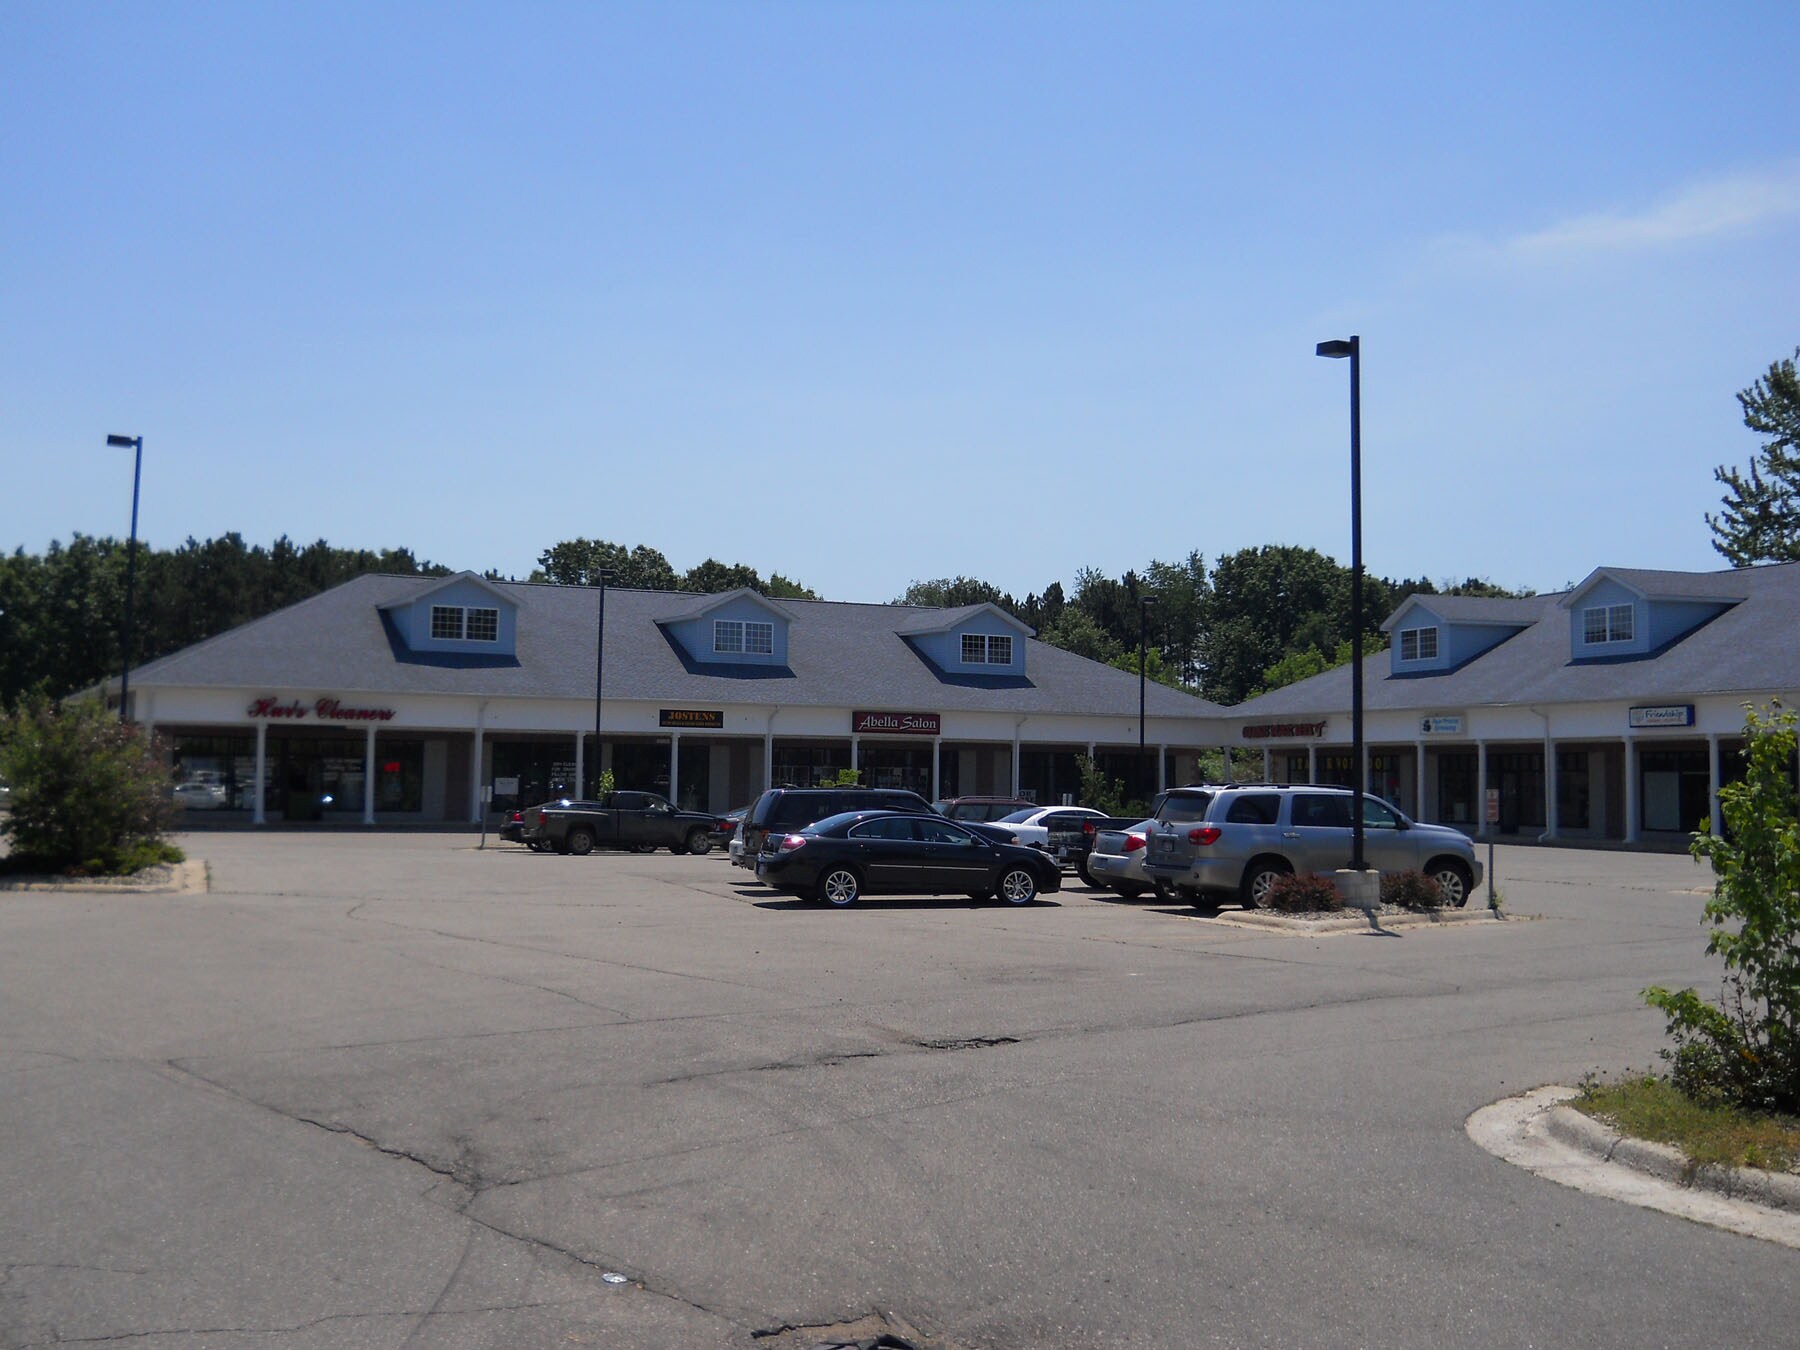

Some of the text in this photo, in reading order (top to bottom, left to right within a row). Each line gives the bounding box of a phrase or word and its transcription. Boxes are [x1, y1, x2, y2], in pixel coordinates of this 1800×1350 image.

[314, 697, 396, 720] Cleaners
[668, 711, 716, 721] JOSTENS
[858, 715, 937, 730] Abella Salon
